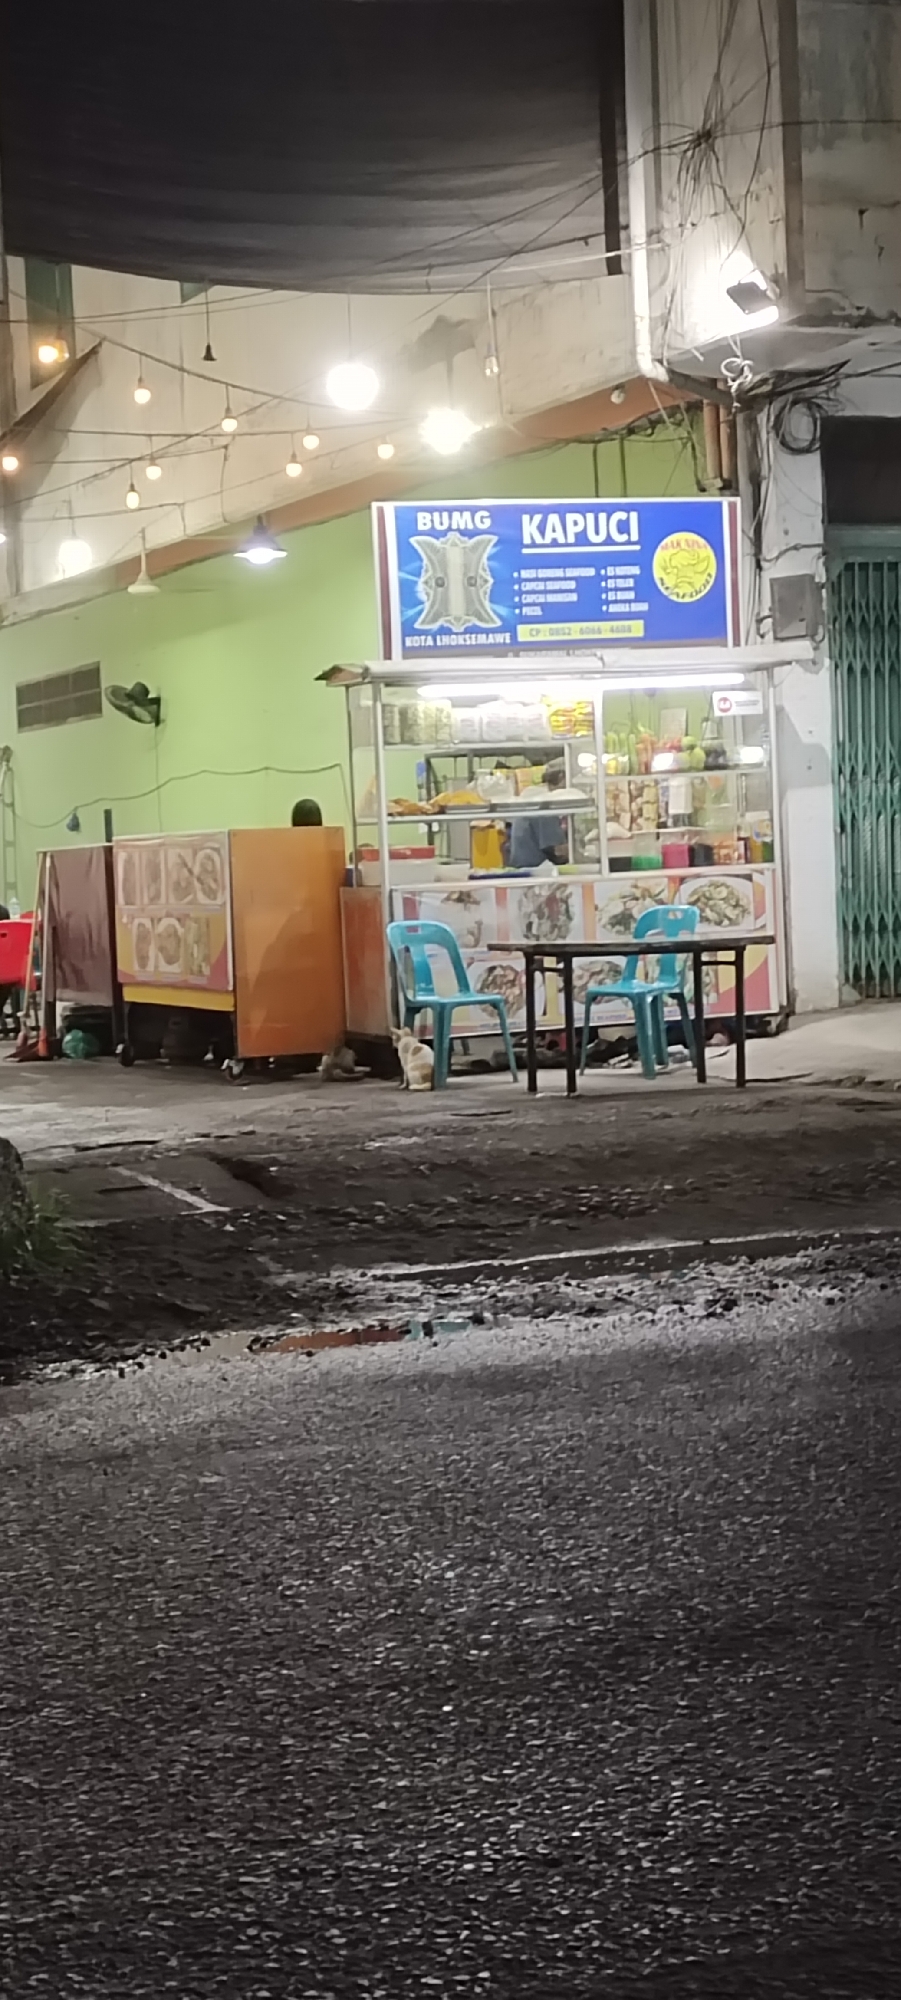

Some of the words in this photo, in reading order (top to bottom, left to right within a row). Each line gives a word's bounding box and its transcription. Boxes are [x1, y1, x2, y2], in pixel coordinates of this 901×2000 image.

[416, 510, 491, 531] BUMG
[521, 511, 640, 545] KAPUCI
[565, 567, 596, 577] SEAFOOD
[546, 580, 577, 590] SEAFOOD
[658, 572, 713, 600] SEAFOOD
[404, 635, 434, 648] KOTA
[435, 632, 511, 647] LHOKSEMAWE
[528, 627, 541, 638] CP
